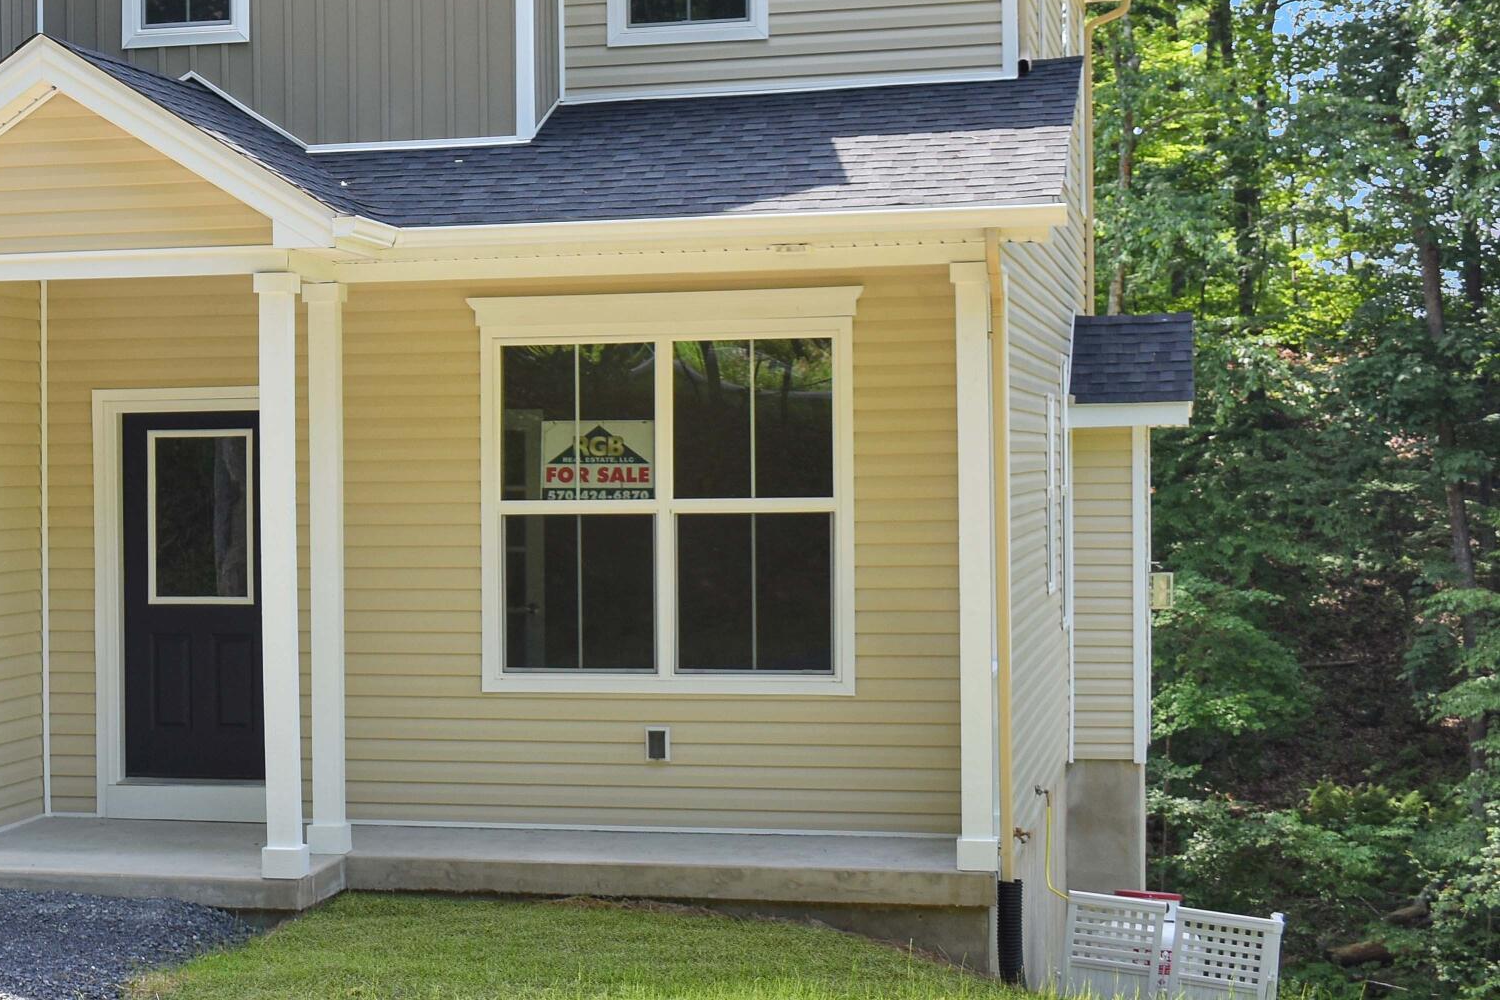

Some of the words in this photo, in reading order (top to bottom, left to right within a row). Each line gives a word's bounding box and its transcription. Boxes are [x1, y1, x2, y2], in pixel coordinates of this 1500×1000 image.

[572, 435, 625, 457] RGB
[546, 466, 590, 484] FOR
[597, 466, 650, 484] SALE
